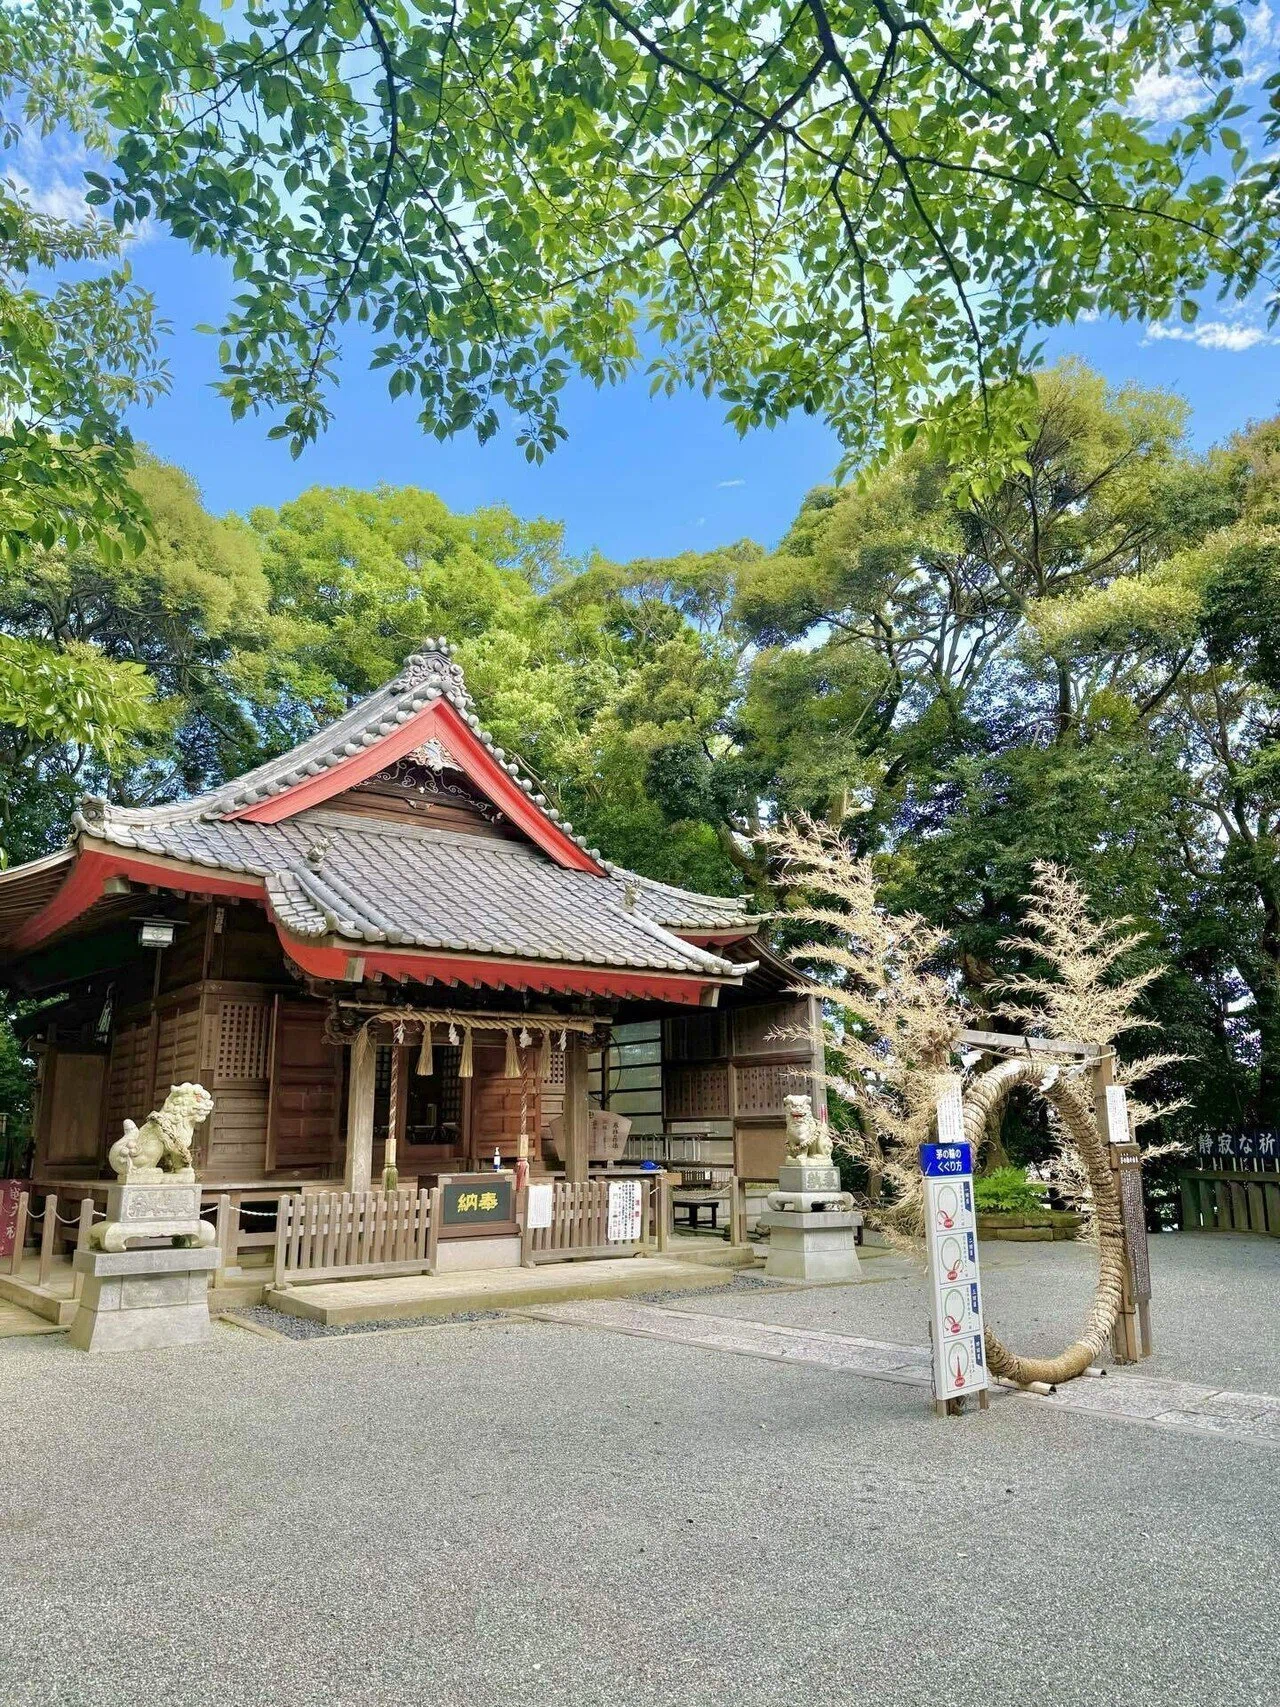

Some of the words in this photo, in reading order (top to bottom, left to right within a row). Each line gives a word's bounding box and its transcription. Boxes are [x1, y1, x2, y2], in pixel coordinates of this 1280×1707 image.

[935, 1149, 962, 1160] 茅の輪の
[937, 1161, 962, 1172] くぐり方
